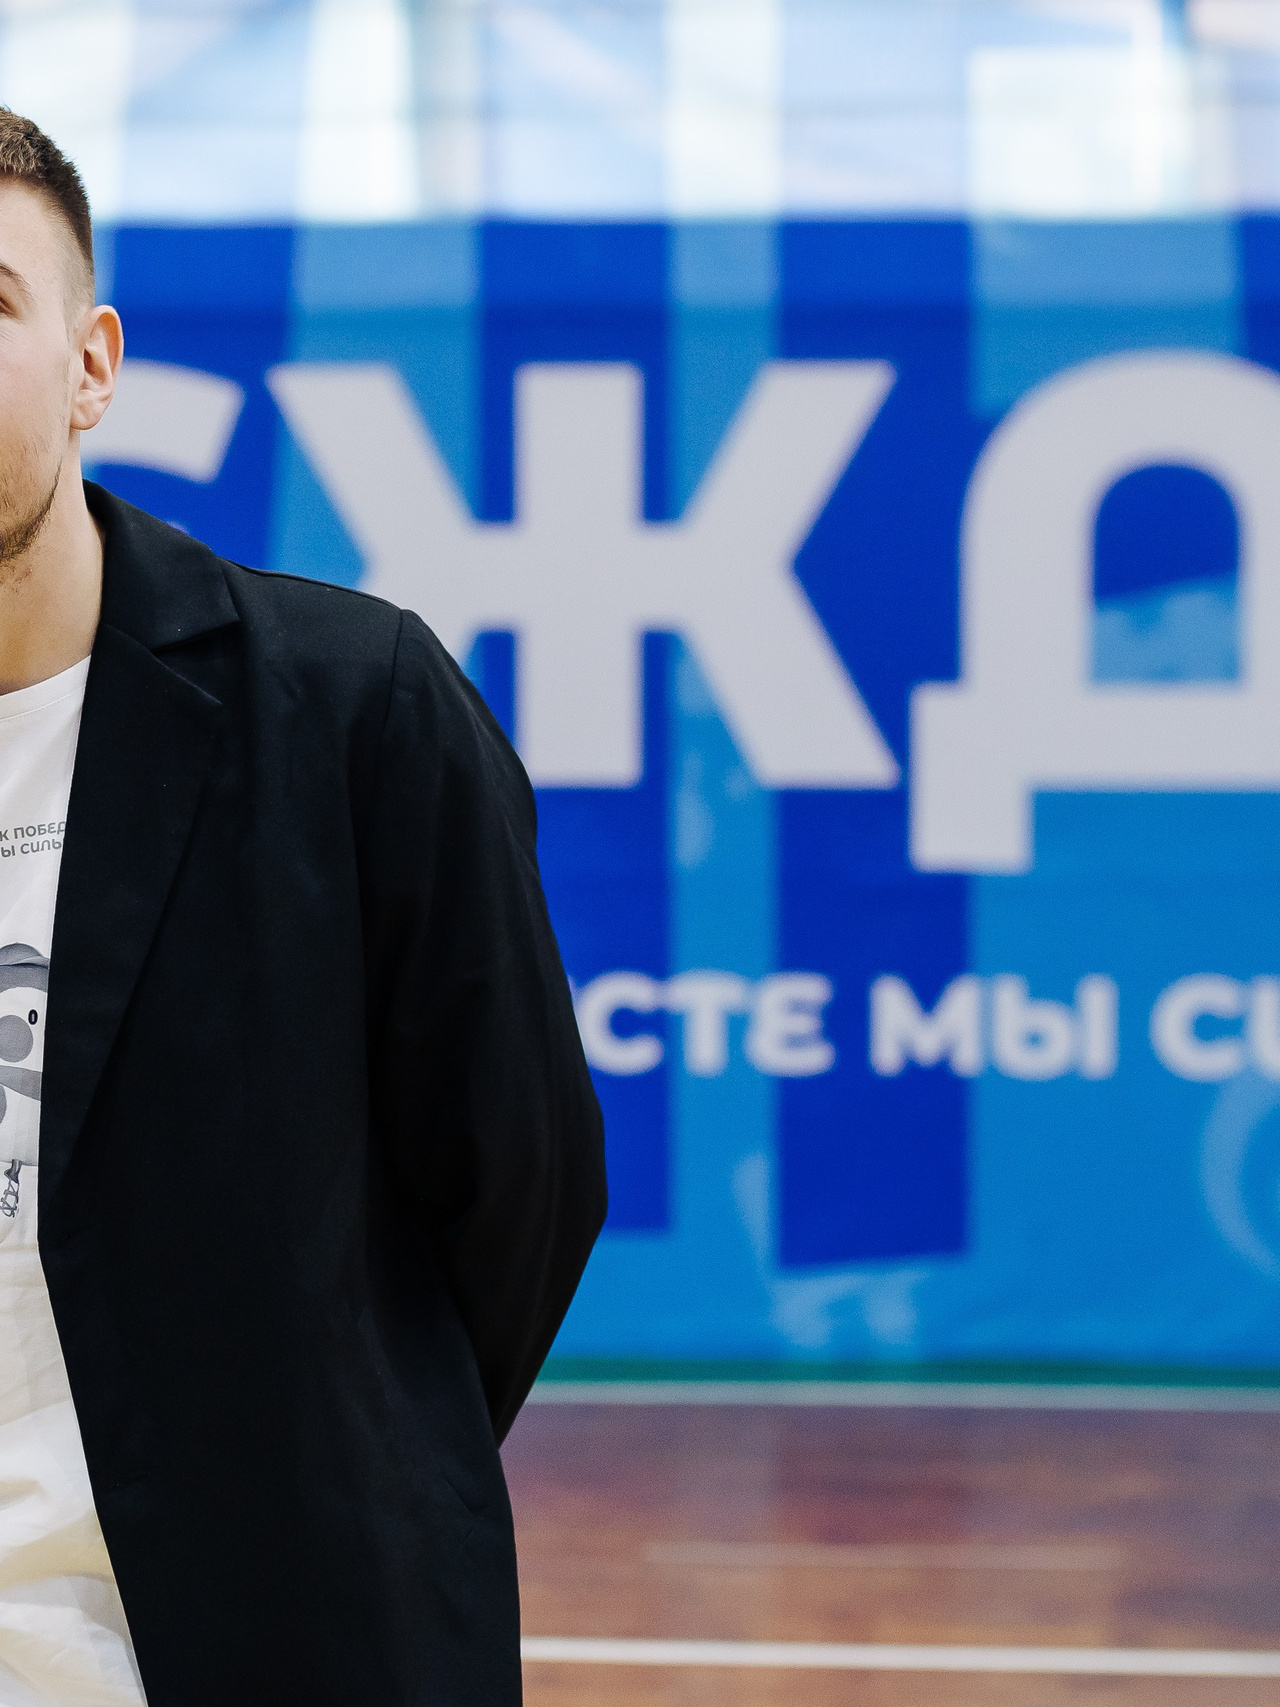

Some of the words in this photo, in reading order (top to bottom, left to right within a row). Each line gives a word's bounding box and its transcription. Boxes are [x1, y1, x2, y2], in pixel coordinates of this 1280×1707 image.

[0, 829, 10, 842] К
[13, 820, 66, 840] ПОБЕД
[20, 838, 63, 855] СИЛЬ
[569, 969, 836, 1078] СТЕ
[870, 971, 1119, 1082] МЫ
